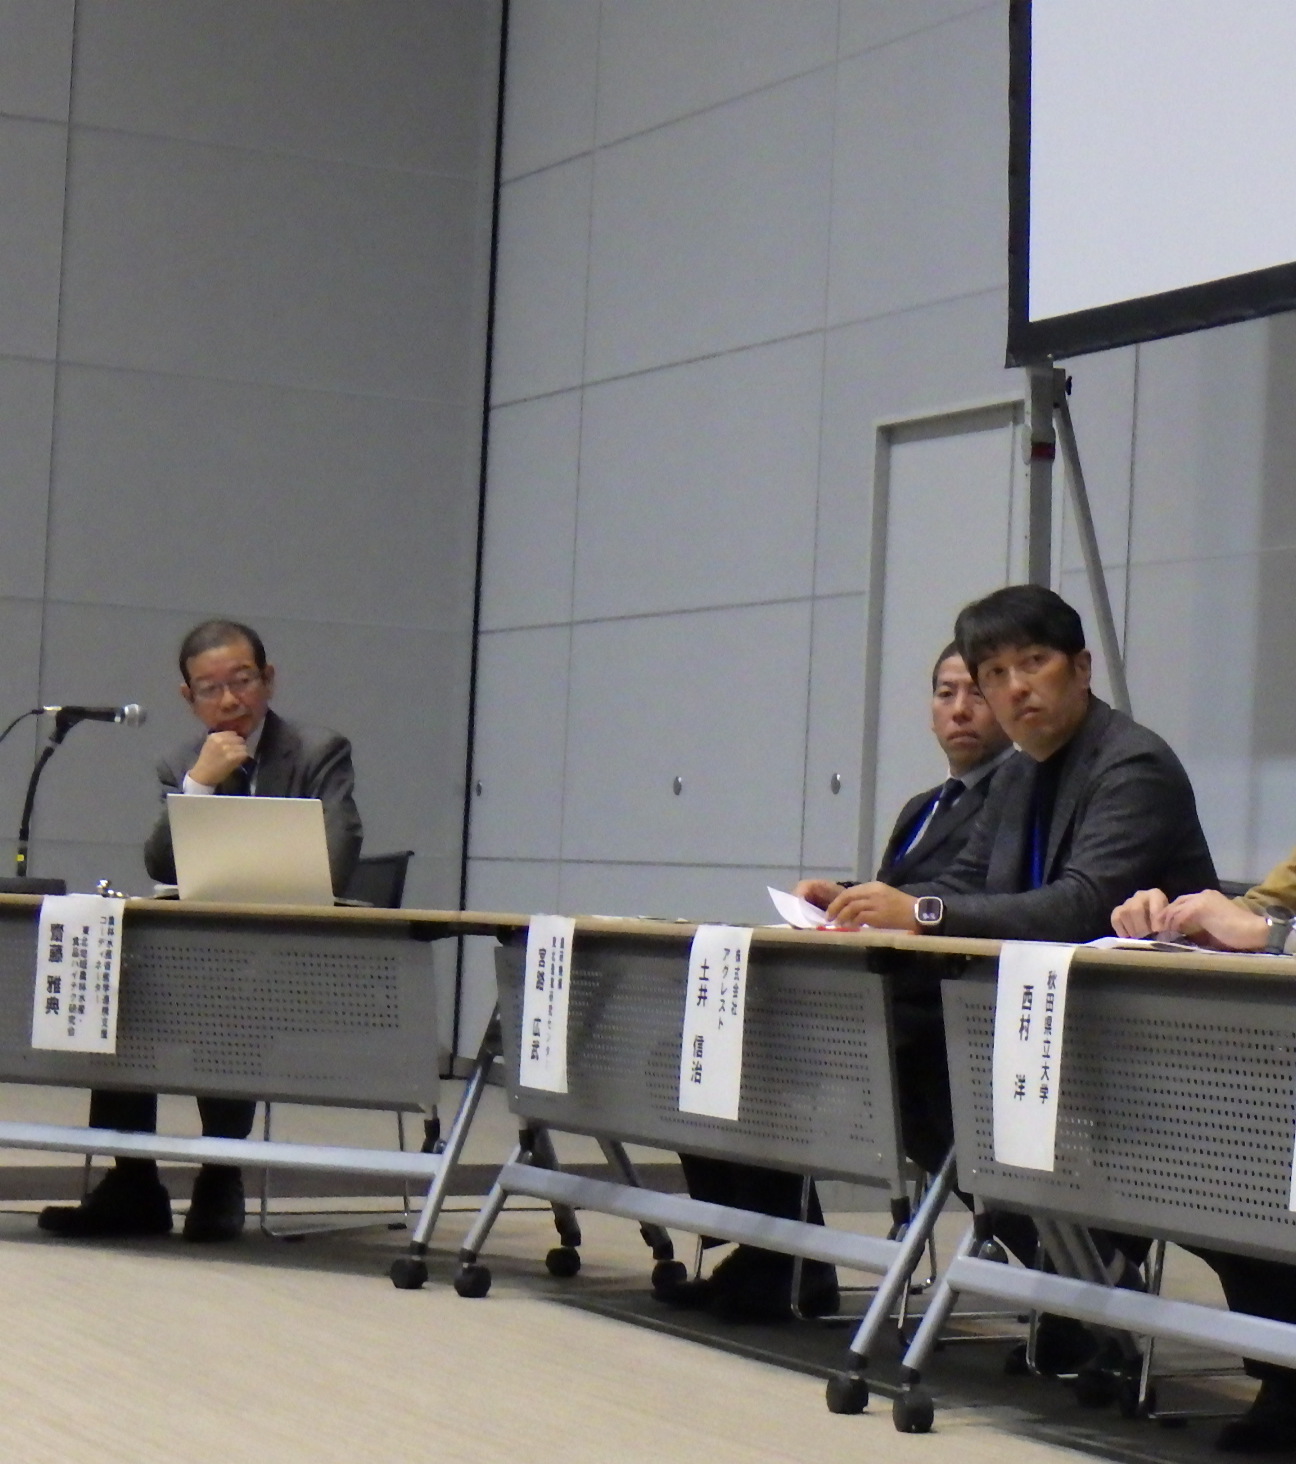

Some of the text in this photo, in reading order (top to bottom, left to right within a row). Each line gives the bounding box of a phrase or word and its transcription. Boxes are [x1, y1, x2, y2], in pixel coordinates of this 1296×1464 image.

[45, 974, 62, 1016] 雅典
[690, 958, 710, 1085] 土井 信治
[717, 948, 731, 1030] アクレスト
[1014, 985, 1034, 1102] 西村 洋
[1039, 970, 1057, 1104] 秋田県立大学
